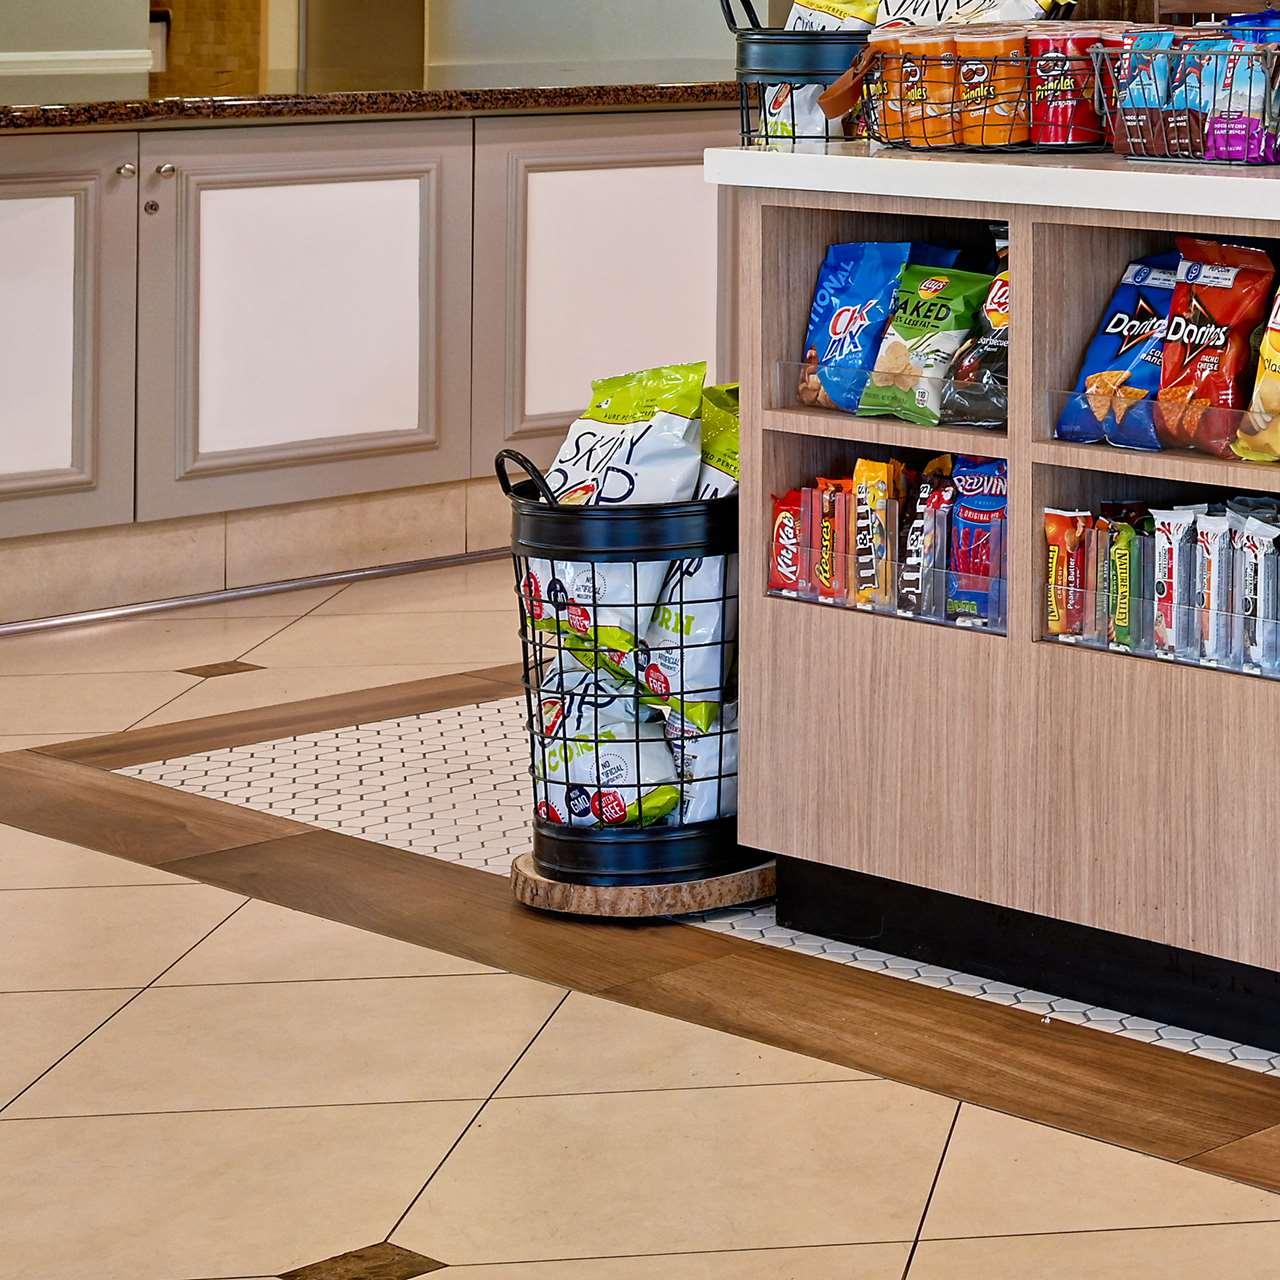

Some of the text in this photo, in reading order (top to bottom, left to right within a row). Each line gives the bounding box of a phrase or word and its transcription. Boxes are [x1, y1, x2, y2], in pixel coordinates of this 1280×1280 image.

[1035, 76, 1076, 102] Pringles
[920, 277, 949, 291] Lay's
[1166, 317, 1228, 346] Doritos
[1139, 353, 1163, 366] RANC
[1117, 552, 1128, 589] NATURE
[570, 795, 589, 813] GMO
